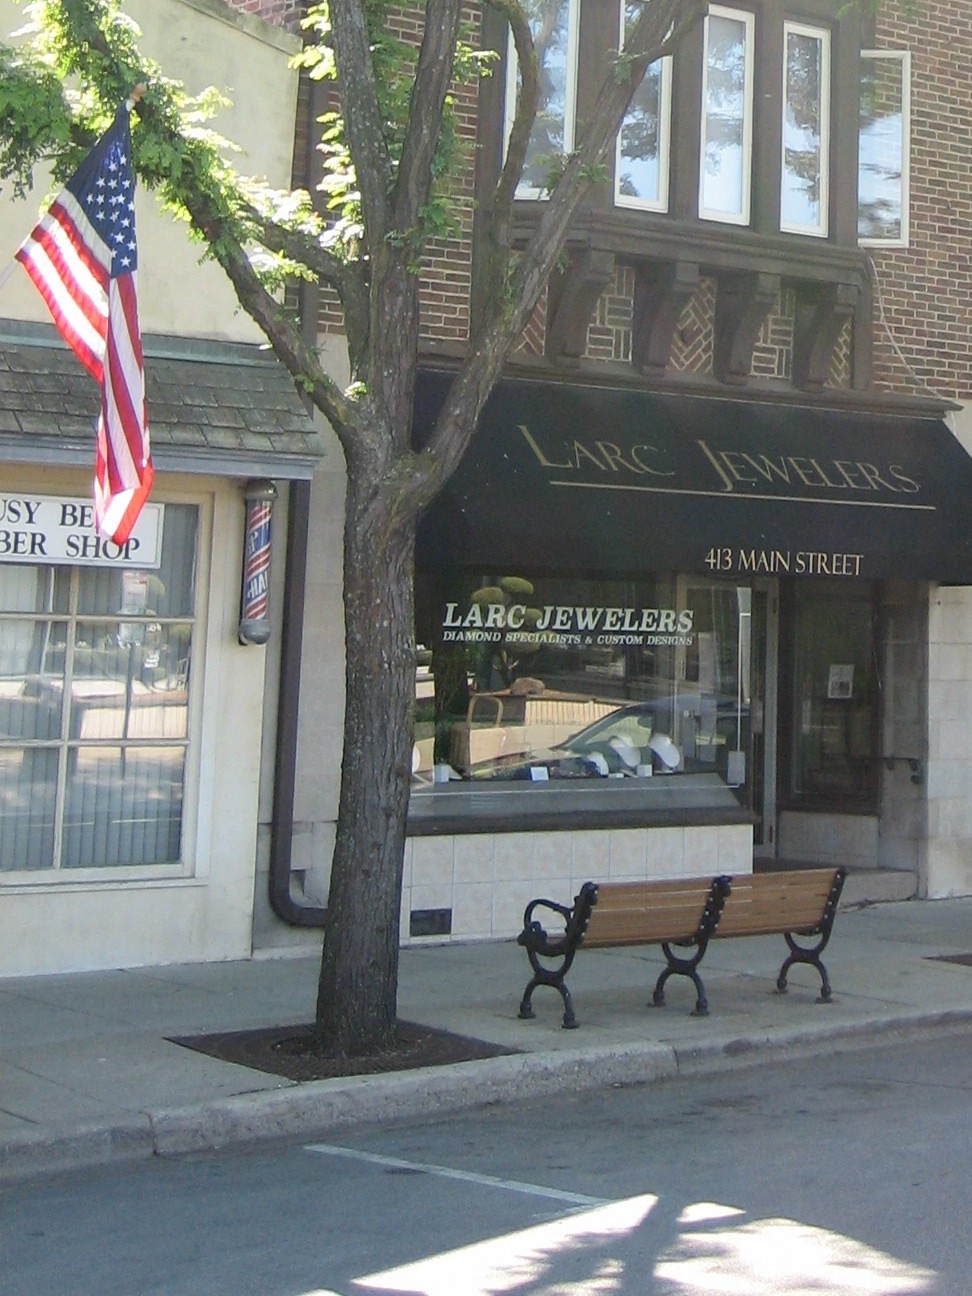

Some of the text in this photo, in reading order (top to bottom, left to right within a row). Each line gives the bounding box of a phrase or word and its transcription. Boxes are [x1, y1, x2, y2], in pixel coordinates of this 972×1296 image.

[518, 425, 922, 493] LARC JEWELERS
[0, 500, 94, 528] SY BE
[66, 534, 140, 560] SHOP
[705, 548, 863, 576] 413 MAIN STREET
[442, 603, 694, 632] LARC JEWELERS
[443, 631, 693, 645] DIAMOND SPECIALISTS & CUSTOM DESIGNS
